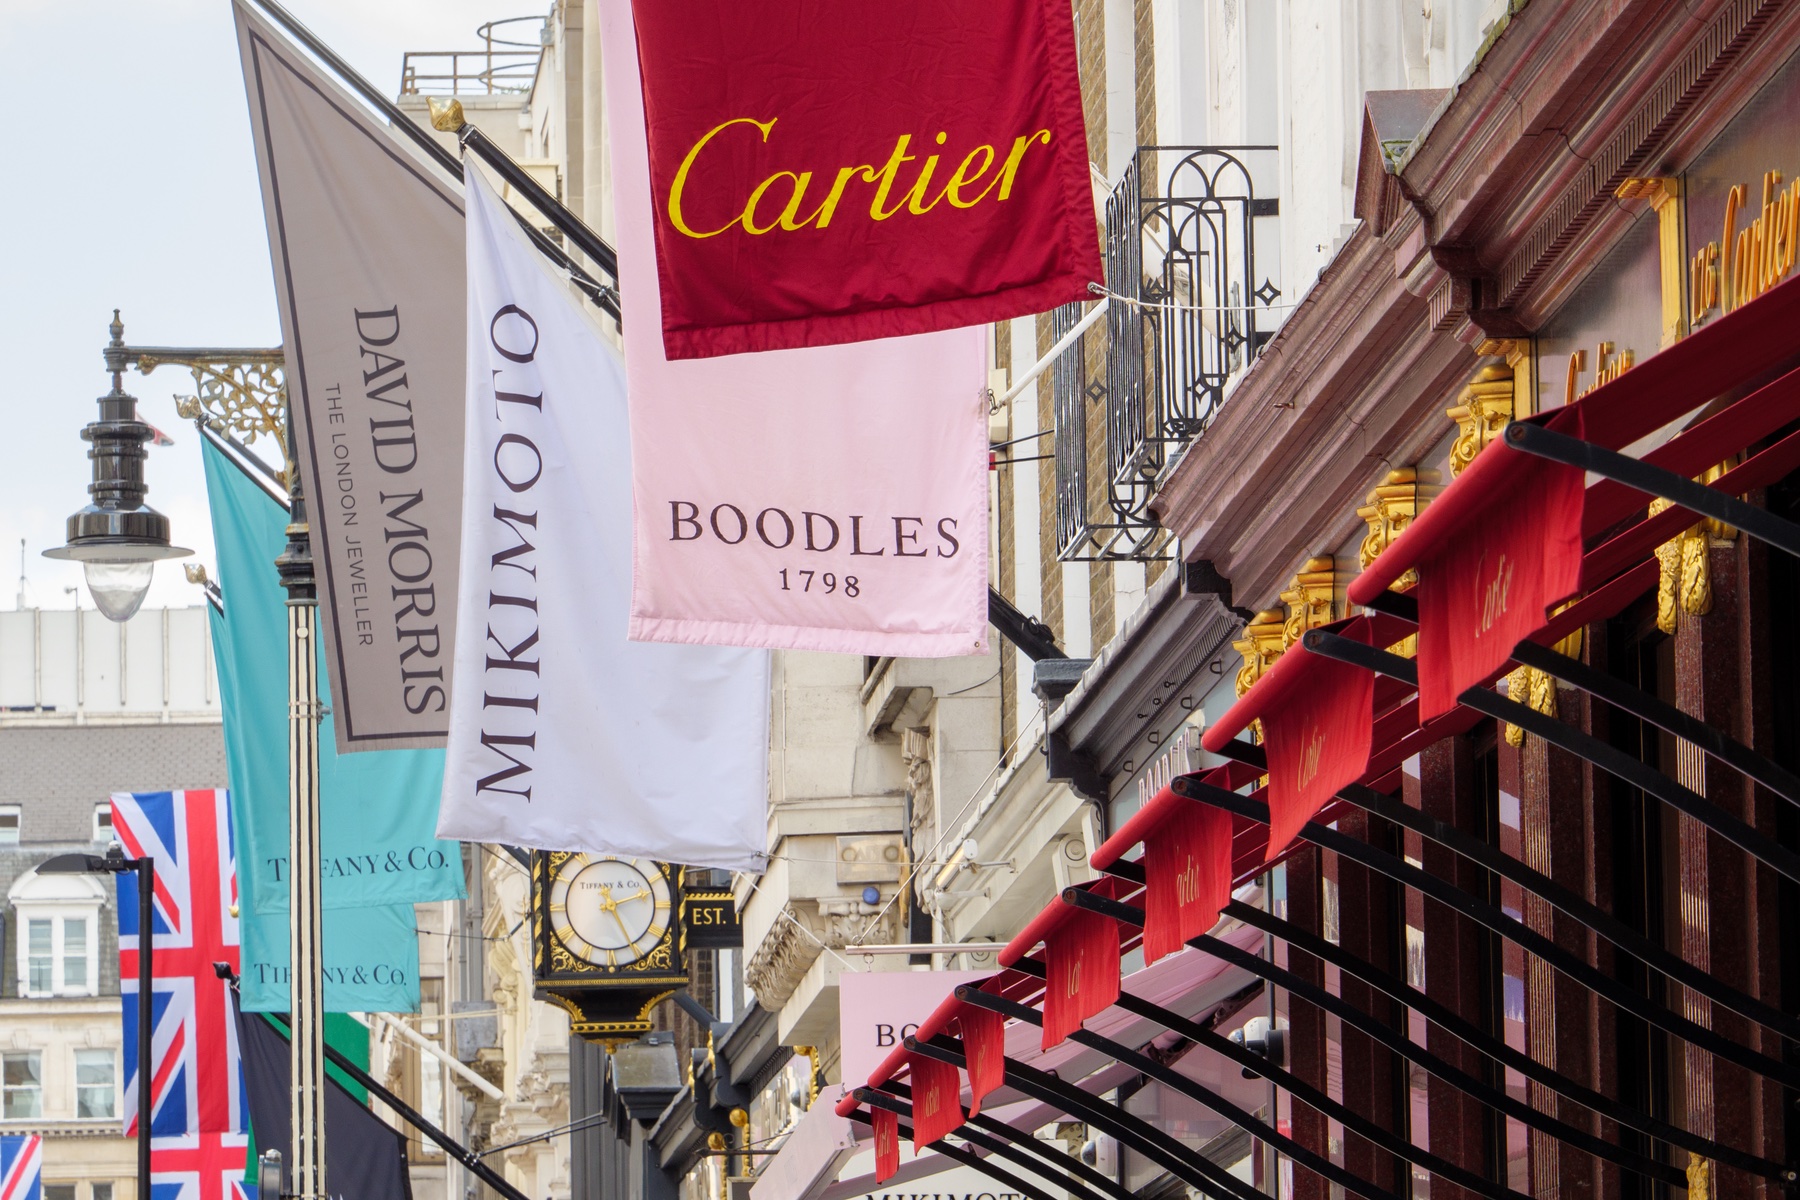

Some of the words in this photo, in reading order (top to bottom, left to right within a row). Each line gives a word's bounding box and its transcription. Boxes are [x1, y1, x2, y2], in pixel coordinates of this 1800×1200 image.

[668, 117, 1051, 239] Cartier
[325, 382, 345, 425] THE
[354, 304, 418, 474] DAVID
[331, 433, 359, 527] LONDON
[476, 304, 543, 803] MIKIMOTO
[668, 500, 960, 559] BOODLES
[345, 535, 374, 646] JEWELLER
[379, 488, 446, 715] MORRIS
[779, 568, 860, 598] 1798
[267, 854, 380, 882] TFANY
[384, 850, 403, 873] &
[617, 880, 624, 889] &
[692, 907, 727, 925] EST.
[254, 963, 349, 984] TIFNY
[352, 965, 369, 985] &
